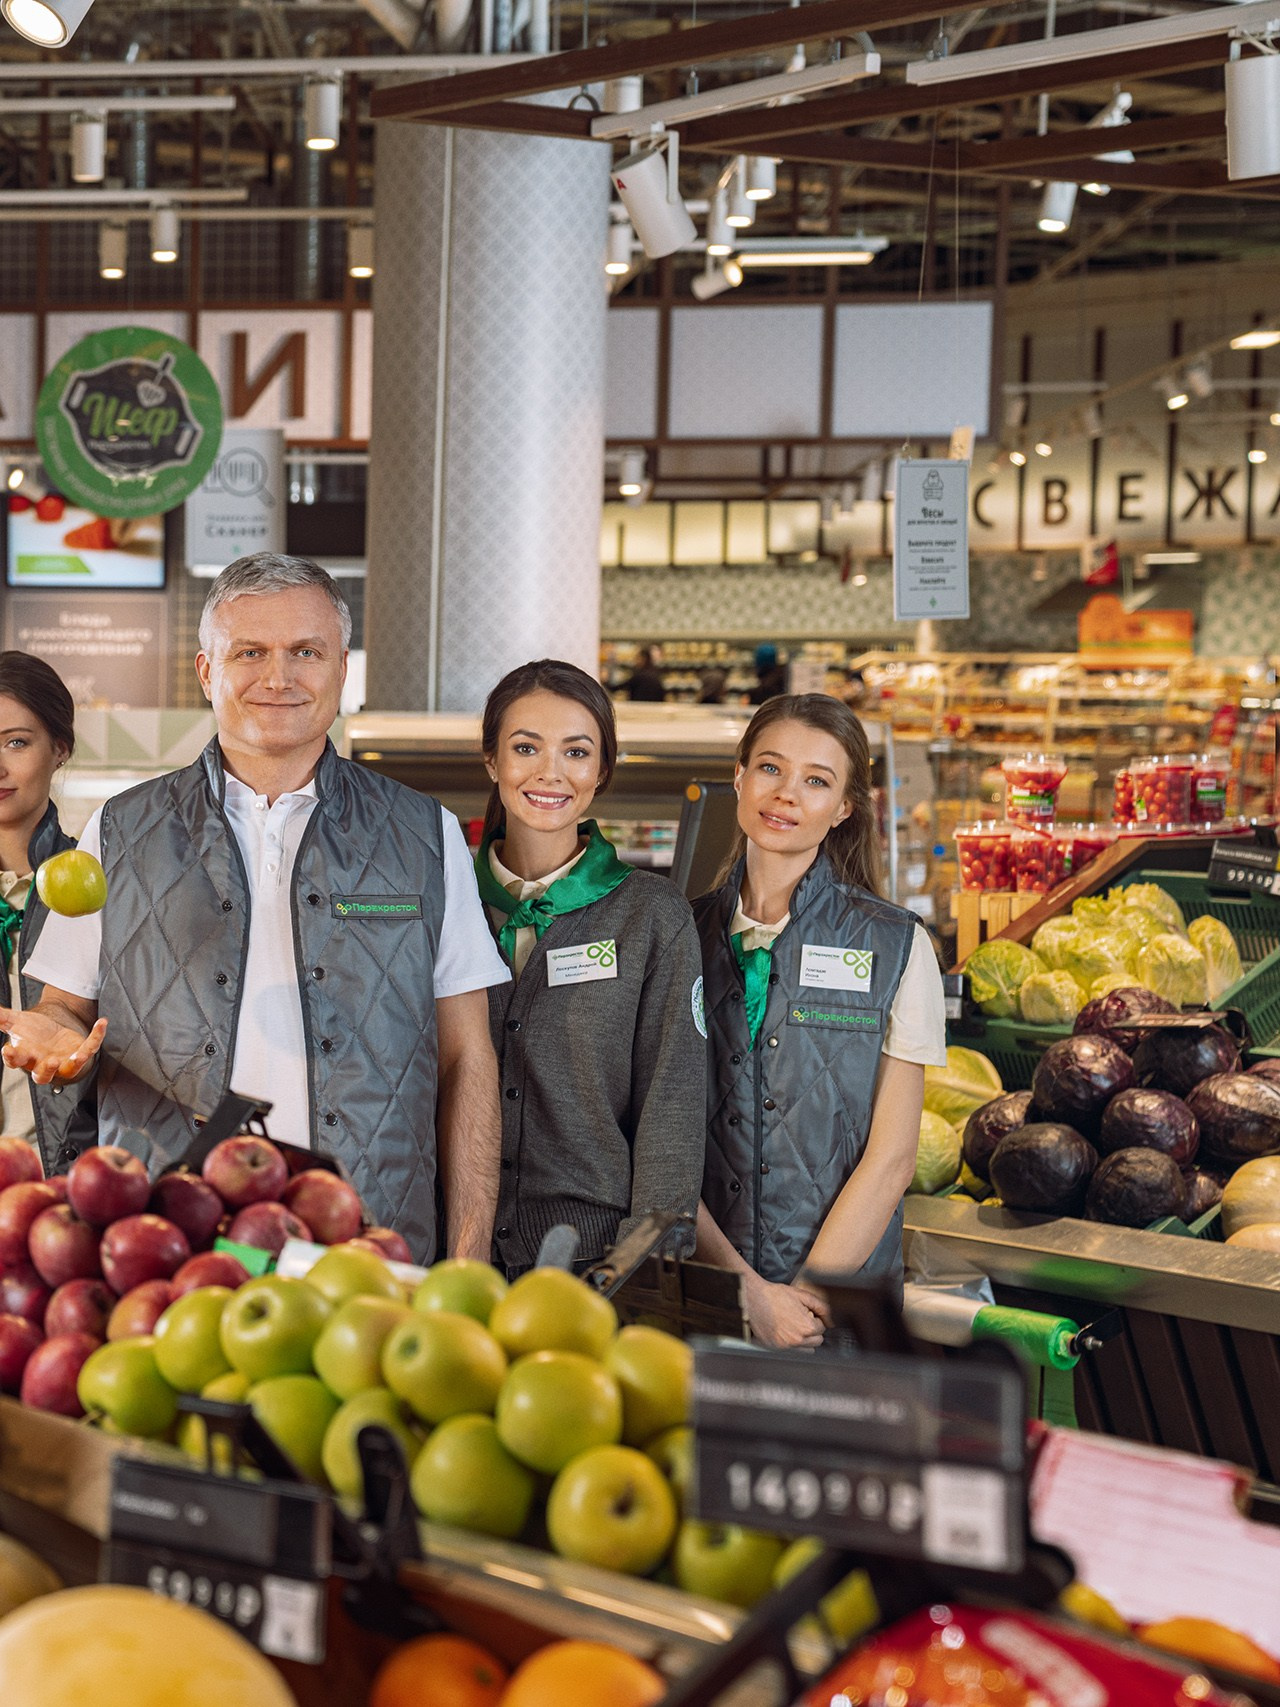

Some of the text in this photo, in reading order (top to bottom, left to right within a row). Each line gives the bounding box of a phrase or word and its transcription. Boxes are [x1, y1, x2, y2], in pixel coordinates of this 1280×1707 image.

[973, 466, 1280, 528] СВЕЖ
[353, 903, 418, 914] Перекресток
[811, 1010, 877, 1025] Перекресток
